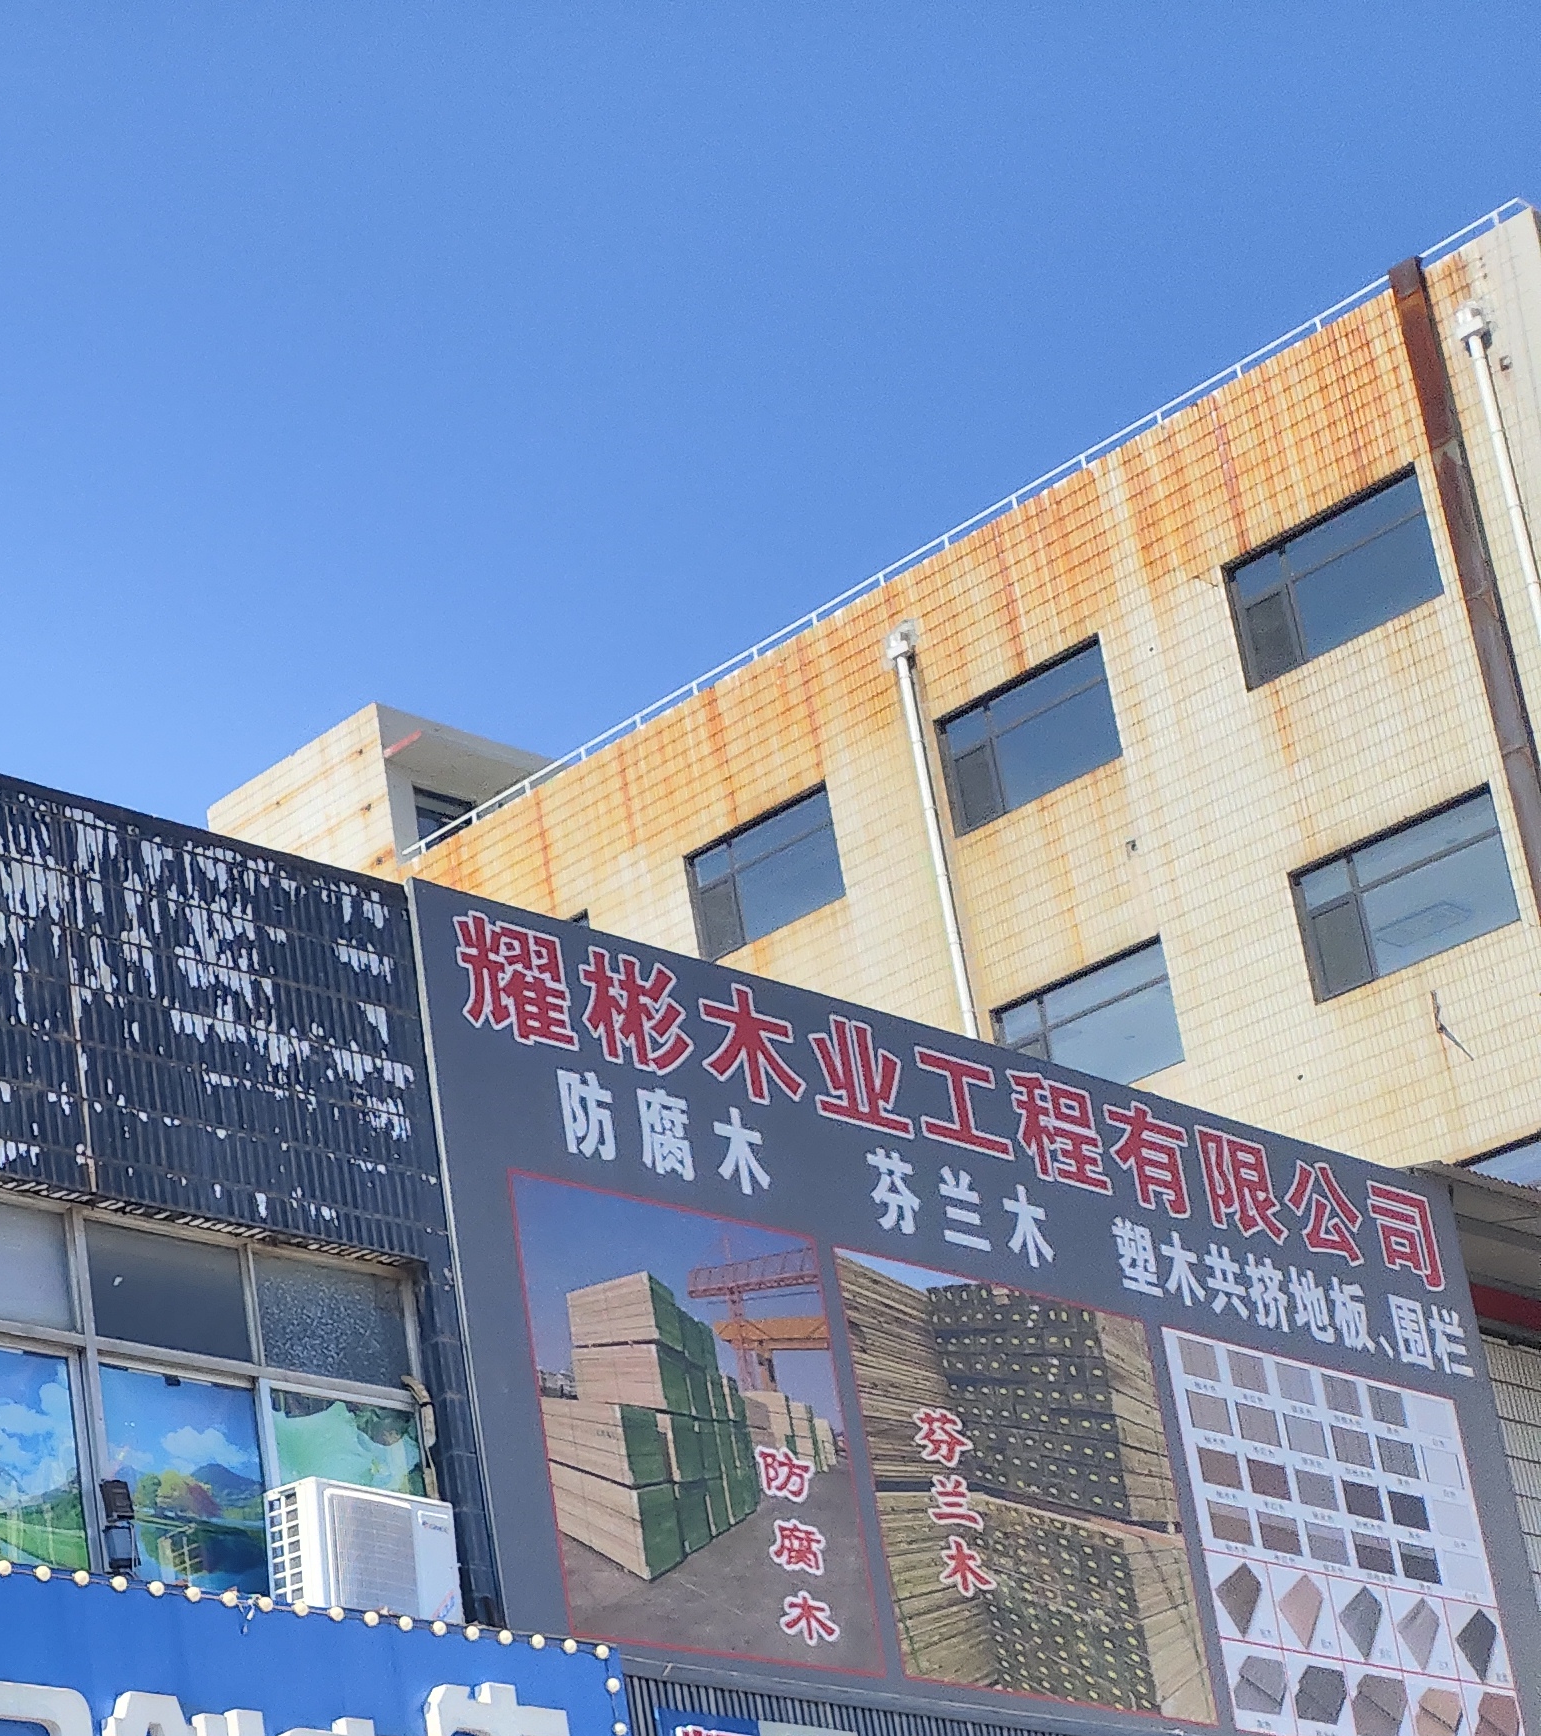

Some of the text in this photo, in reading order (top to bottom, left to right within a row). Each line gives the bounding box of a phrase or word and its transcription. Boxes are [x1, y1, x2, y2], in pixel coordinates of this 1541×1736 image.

[453, 908, 1446, 1293] 耀彬木业工程有限公司
[557, 1067, 772, 1196] 防腐木
[866, 1147, 1057, 1269] 芬兰木
[1111, 1216, 1475, 1379] 塑木共挤地板、围栏
[755, 1445, 840, 1646] 防腐木
[912, 1408, 997, 1598] 芬兰木
